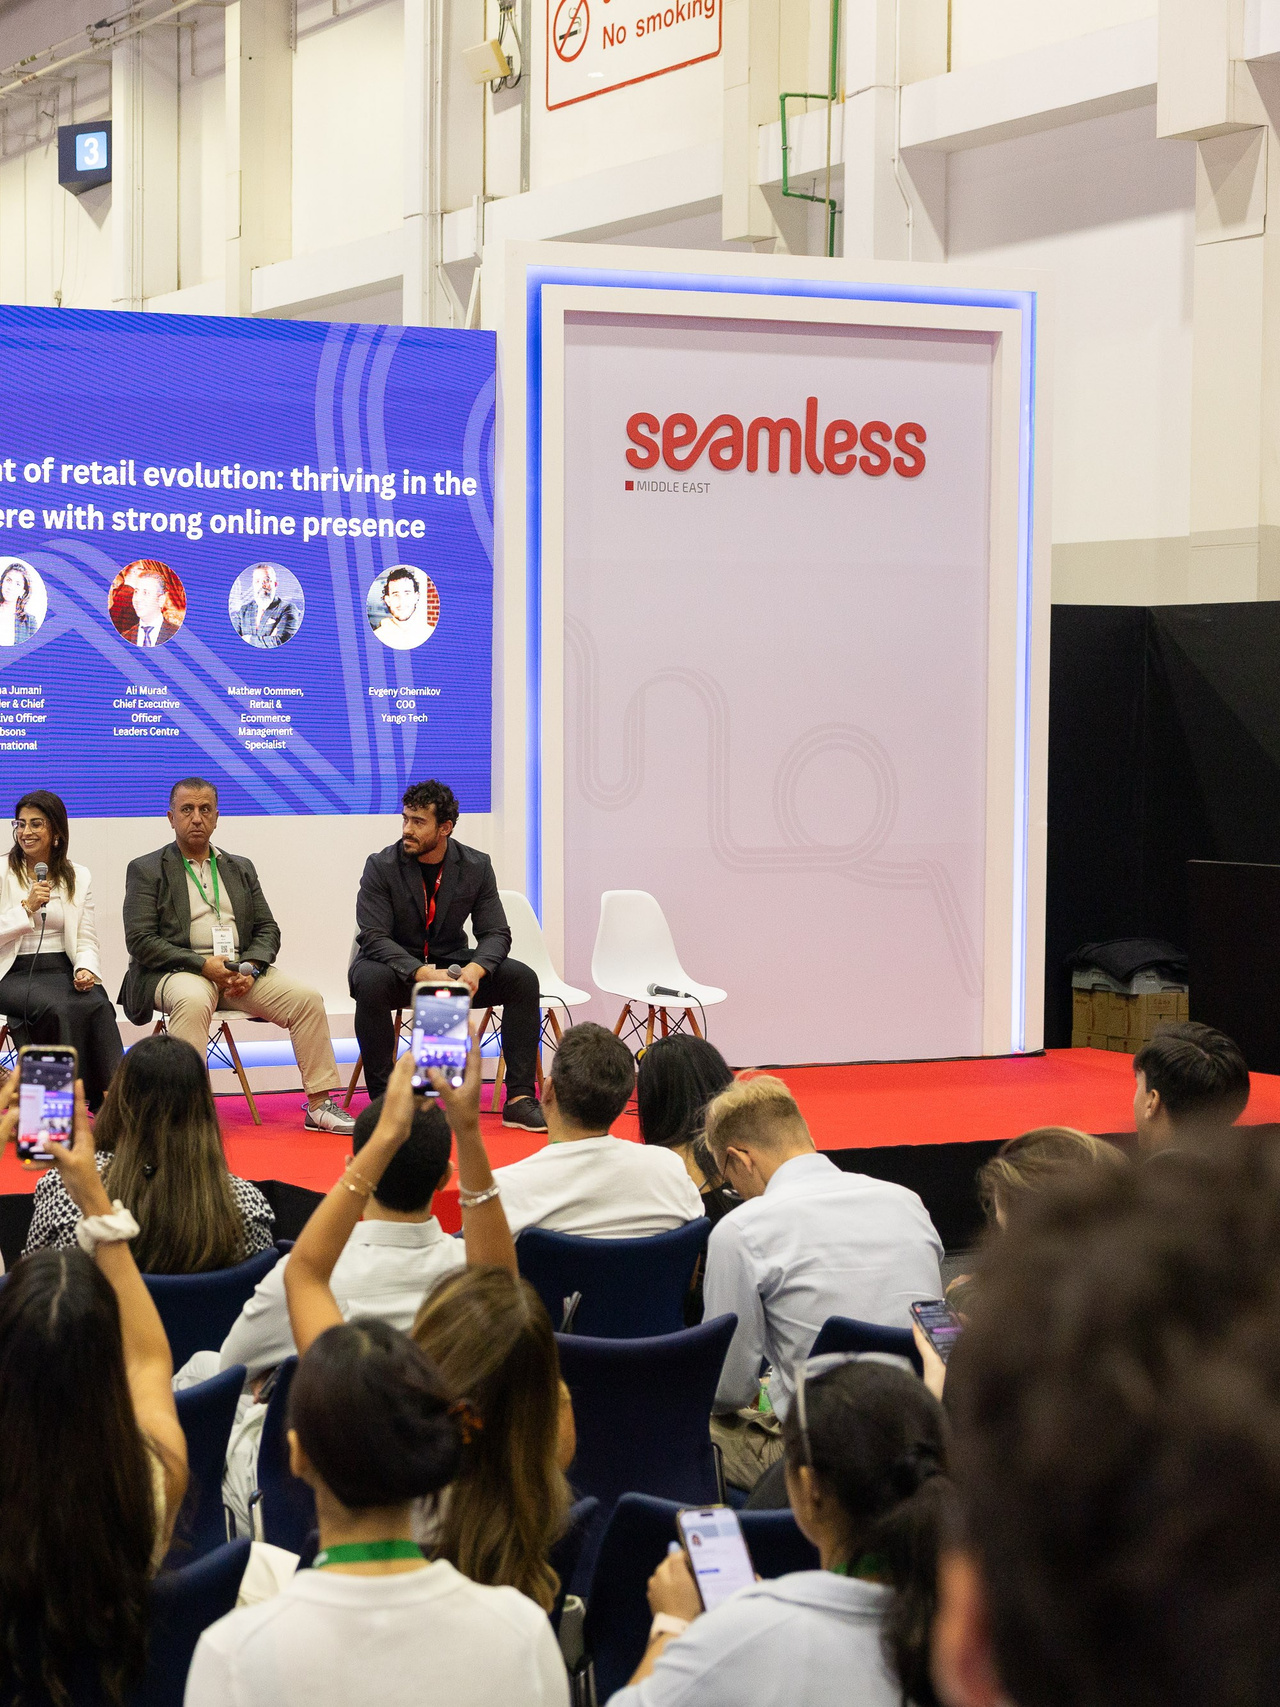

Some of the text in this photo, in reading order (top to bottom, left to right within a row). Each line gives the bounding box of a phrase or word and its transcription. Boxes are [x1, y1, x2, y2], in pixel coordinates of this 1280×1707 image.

[603, 0, 715, 49] No smoking
[84, 137, 99, 166] 3
[625, 396, 927, 478] seamless
[24, 457, 55, 483] of
[62, 459, 135, 486] retail
[143, 463, 284, 490] evolution:
[291, 465, 396, 500] thriving
[403, 469, 427, 494] in
[433, 470, 477, 496] the
[636, 480, 710, 494] MIDDLE EAST
[42, 504, 104, 531] with
[111, 508, 203, 540] strong
[210, 508, 296, 536] online
[303, 514, 426, 542] presence
[9, 685, 42, 694] Jumani
[126, 686, 168, 695] Ali Murad
[228, 686, 304, 697] Mathew Oommen,
[368, 686, 441, 698] Evgeny Chernikov
[12, 699, 19, 708] &
[20, 699, 46, 708] Chief
[113, 699, 180, 708] Chief Executive
[250, 700, 282, 708] Retail &
[396, 700, 416, 709] COO
[15, 713, 48, 722] Officer
[131, 713, 162, 722] Officer
[240, 714, 291, 722] Ecommerce
[381, 713, 428, 724] Yango Tech
[114, 727, 180, 736] Leaders Centre
[238, 727, 294, 738] Management
[245, 740, 286, 751] Specialist
